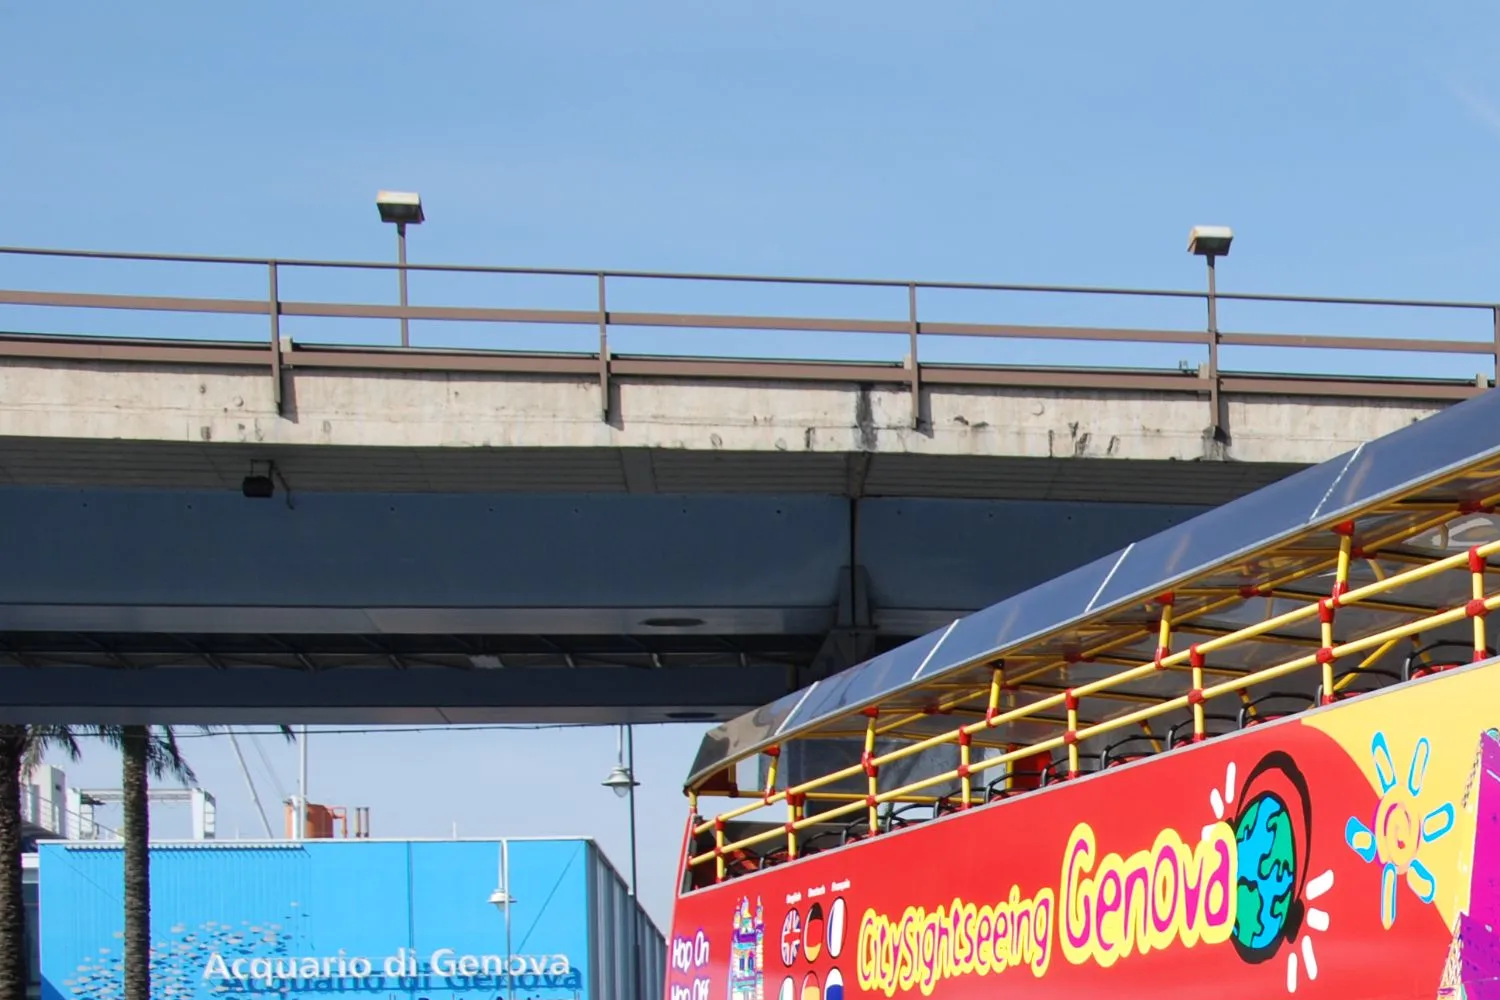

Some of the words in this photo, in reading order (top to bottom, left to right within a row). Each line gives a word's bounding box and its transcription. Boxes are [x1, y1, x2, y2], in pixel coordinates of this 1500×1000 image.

[857, 885, 1054, 998] CitySightseeing
[1059, 821, 1238, 969] Genova
[203, 947, 371, 987] Acquario
[383, 947, 417, 977] di
[430, 950, 572, 978] Genova
[672, 936, 691, 973] Hop
[693, 928, 710, 967] On
